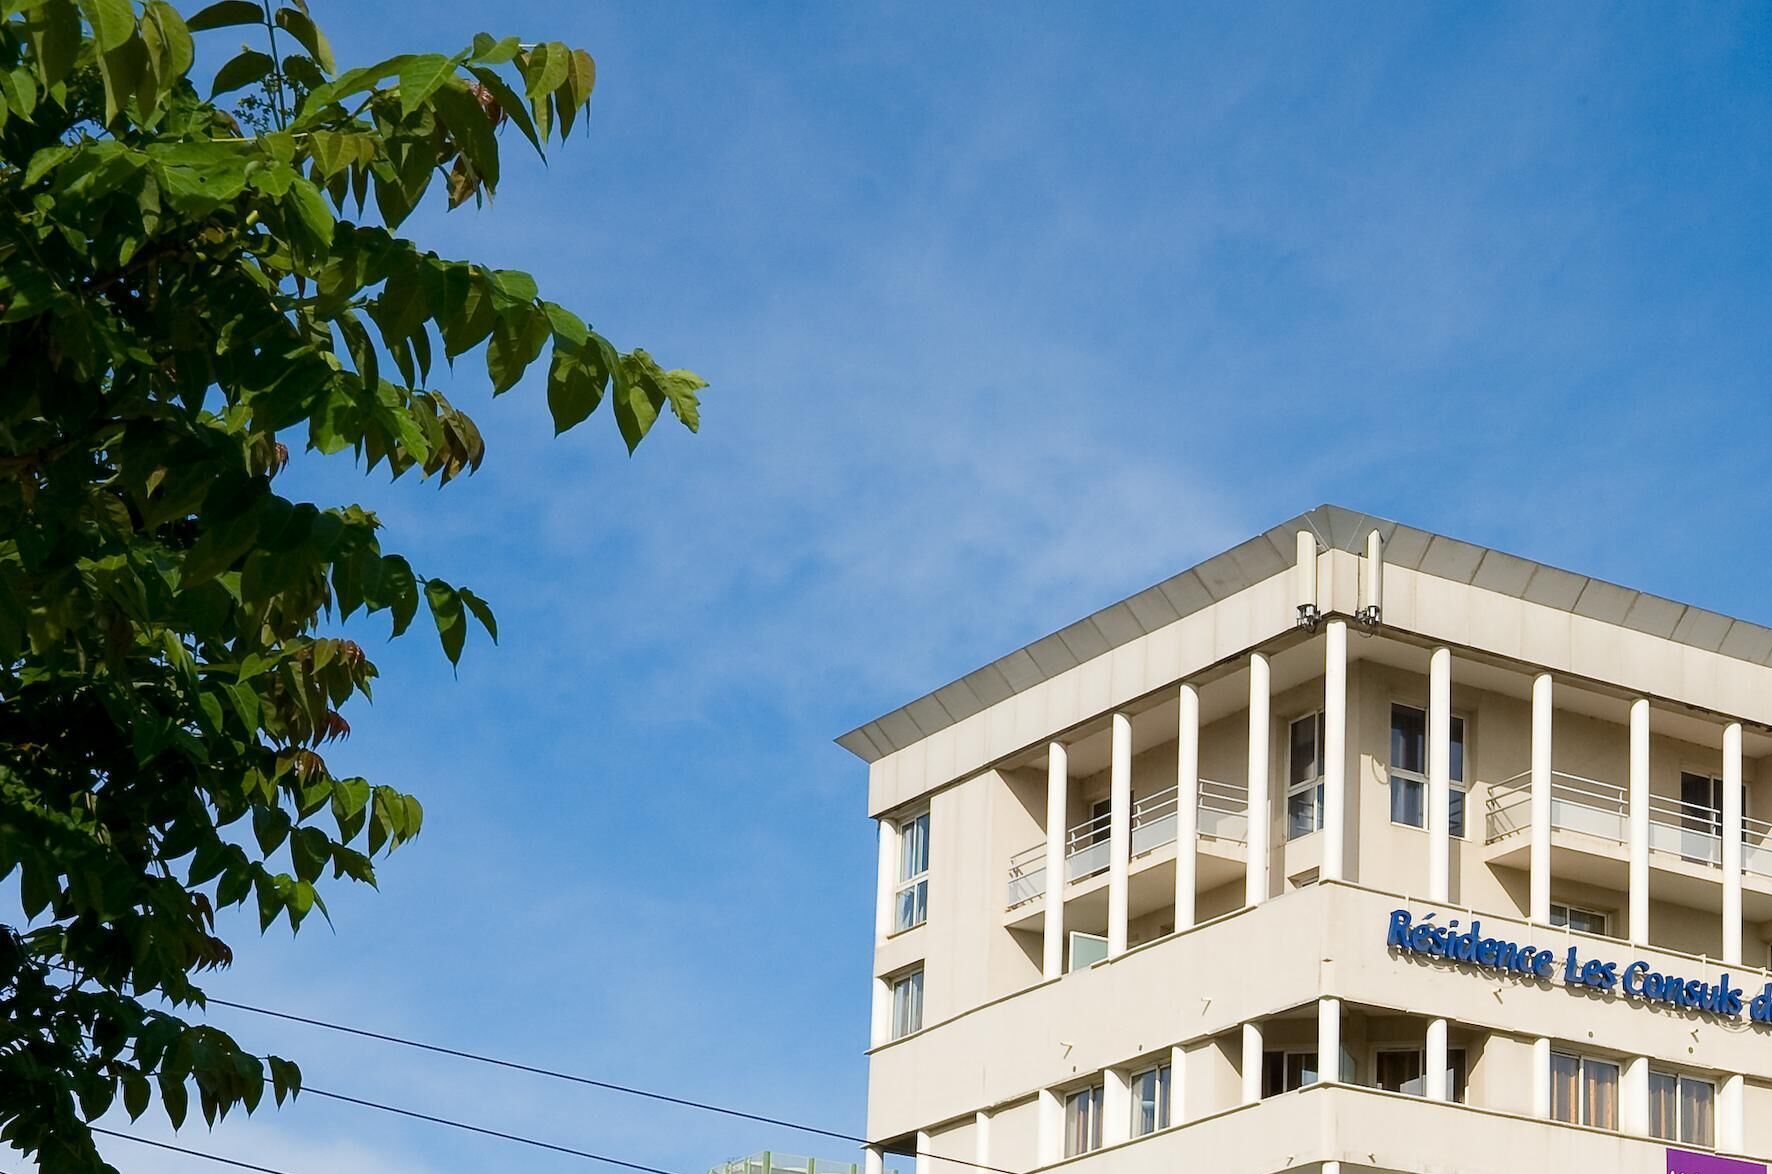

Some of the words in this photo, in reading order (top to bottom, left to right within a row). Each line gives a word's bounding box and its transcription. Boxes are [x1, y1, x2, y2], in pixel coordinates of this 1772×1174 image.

[1387, 909, 1554, 977] Résidence
[1563, 946, 1618, 990] Les
[1622, 961, 1743, 1016] Consuls
